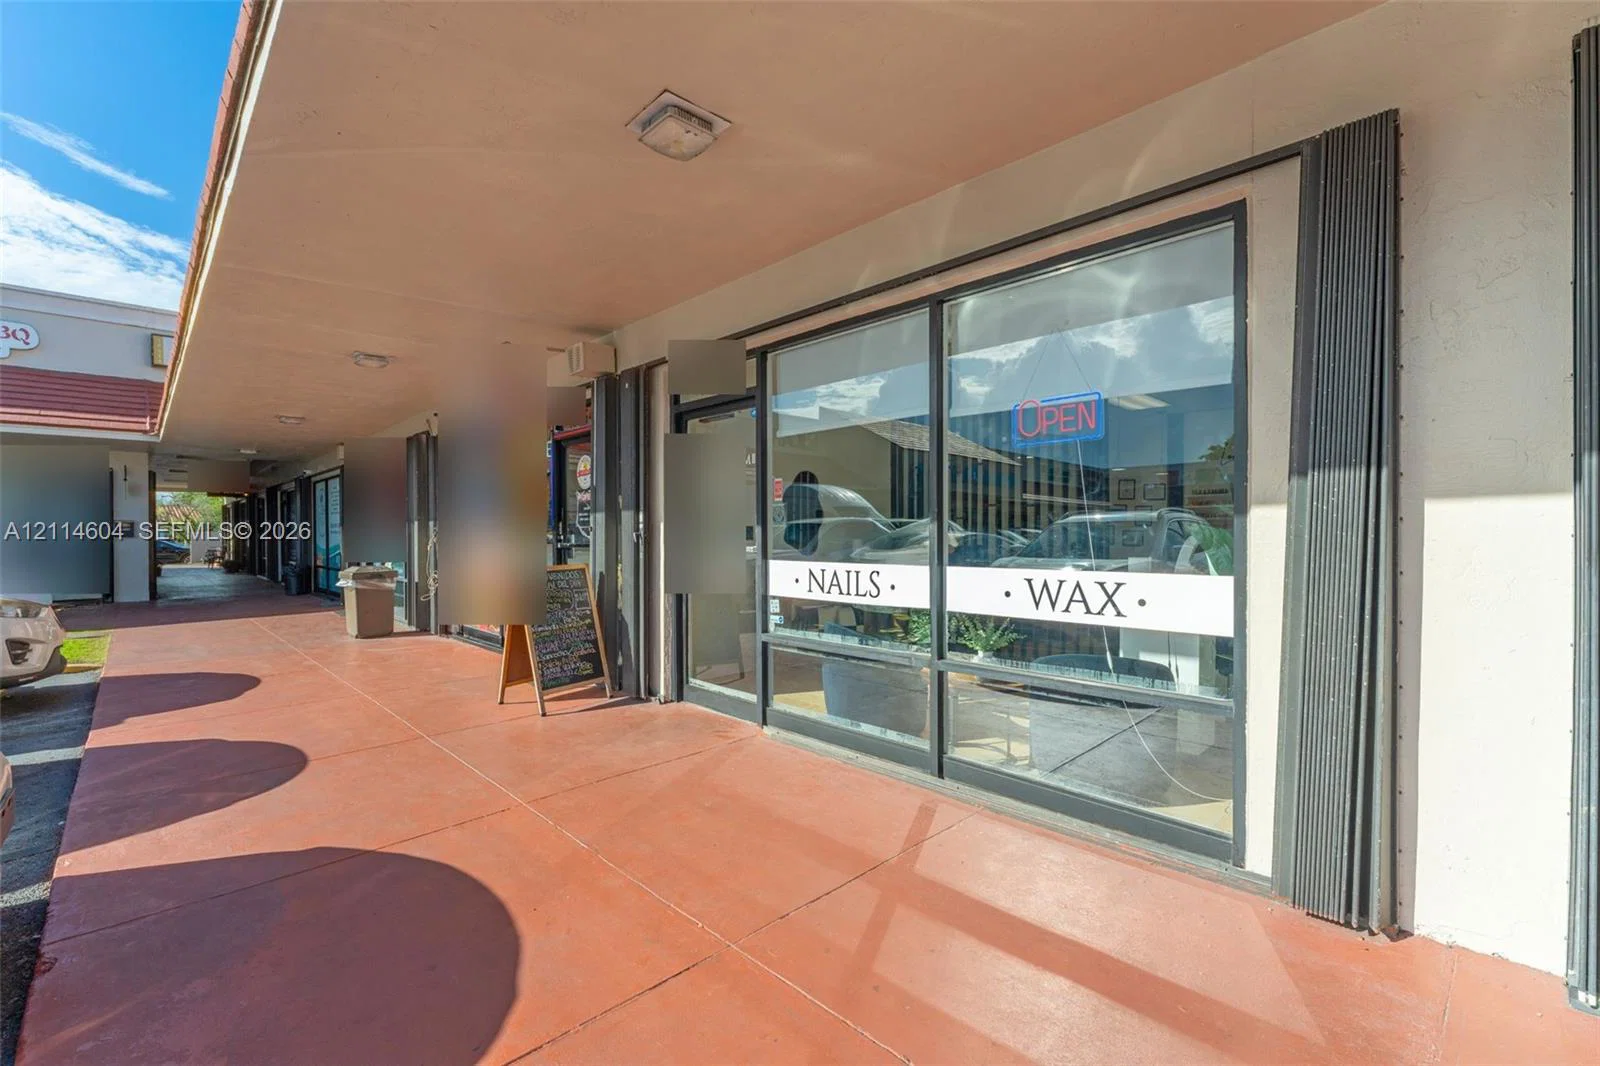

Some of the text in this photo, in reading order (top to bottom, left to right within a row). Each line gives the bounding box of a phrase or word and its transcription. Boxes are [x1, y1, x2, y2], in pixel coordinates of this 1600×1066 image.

[1017, 399, 1097, 437] OPEN
[807, 567, 881, 599] NAILS
[1023, 577, 1127, 618] WAX
